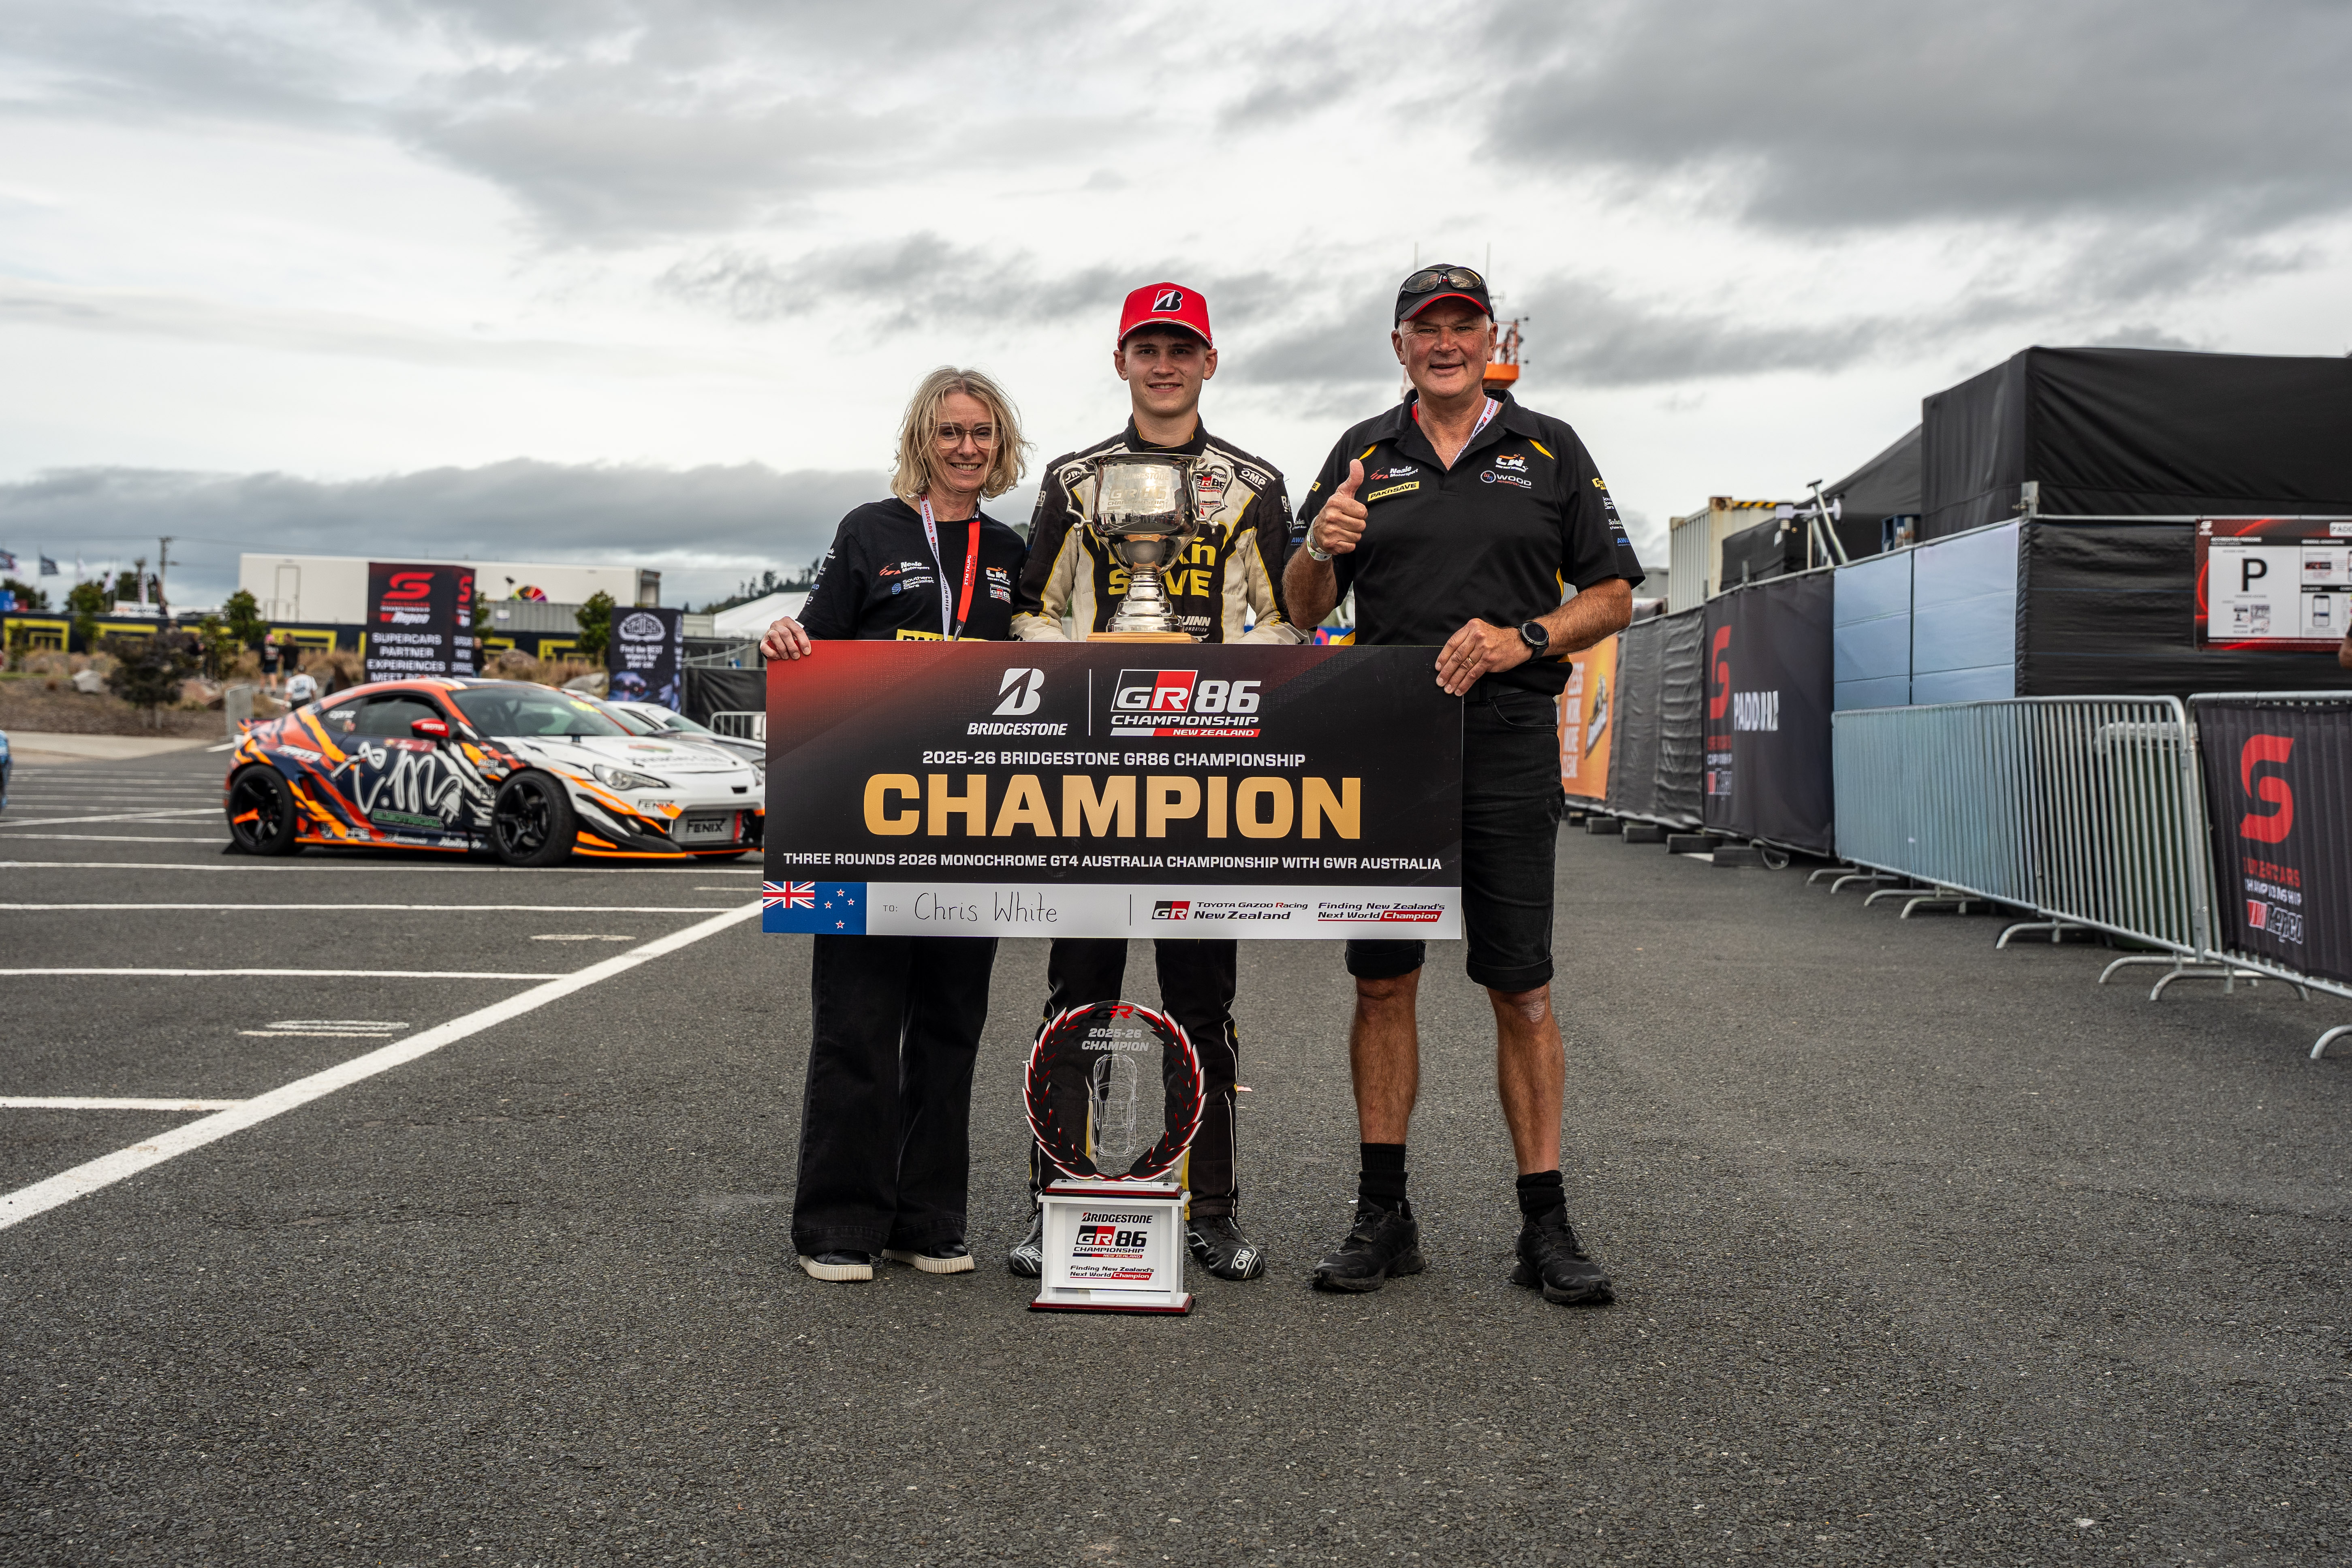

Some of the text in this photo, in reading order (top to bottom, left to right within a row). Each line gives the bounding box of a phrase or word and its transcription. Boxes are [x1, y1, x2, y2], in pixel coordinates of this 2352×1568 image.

[1241, 470, 1266, 486] OMP
[1390, 468, 1418, 477] Motorsport
[1497, 474, 1532, 486] WOOD
[923, 504, 933, 533] SUPERCARS
[902, 576, 933, 584] Southern
[2241, 558, 2268, 592] P
[903, 579, 934, 588] Specialist
[1108, 568, 1212, 598] SVE
[1177, 615, 1211, 626] UINN
[372, 632, 442, 645] SUPERCARS
[379, 646, 434, 658] PARTNER
[620, 644, 663, 654] Find the BEST
[366, 659, 446, 672] EXPERIENCES
[627, 661, 641, 669] your
[370, 672, 404, 682] MEET
[1194, 680, 1261, 713] 86
[1111, 716, 1259, 726] CHAMPIONSHIP
[967, 723, 1068, 736] BRIDGESTONE
[923, 751, 1305, 767] 2025-26 BRIDGESTONE GR86 CHAMPIONSHIP
[638, 799, 674, 808] FENIX
[864, 773, 1361, 839] CHAMPION
[687, 818, 727, 833] FENIX
[784, 853, 1442, 869] THREE ROUNDS 2026 MONOCHROME GT4 AUSTRALIA CHAMPIONSHIP WITH GWR AUSTRALIA
[914, 891, 1057, 923] Chris White
[1275, 901, 1308, 910] Racing
[1318, 901, 1363, 911] Finding
[1393, 902, 1445, 911] Zealand's
[1154, 907, 1188, 919] GR
[1194, 910, 1291, 920] New Zealand
[1318, 911, 1438, 921] Next World Champion
[1088, 1028, 1142, 1038] 2025-26
[1082, 1040, 1149, 1051] CHAMPION
[1081, 1212, 1153, 1224] BRIDGESTONE
[1115, 1230, 1147, 1247] 86
[1021, 1248, 1042, 1262] OMP
[1235, 1250, 1252, 1269] OMP
